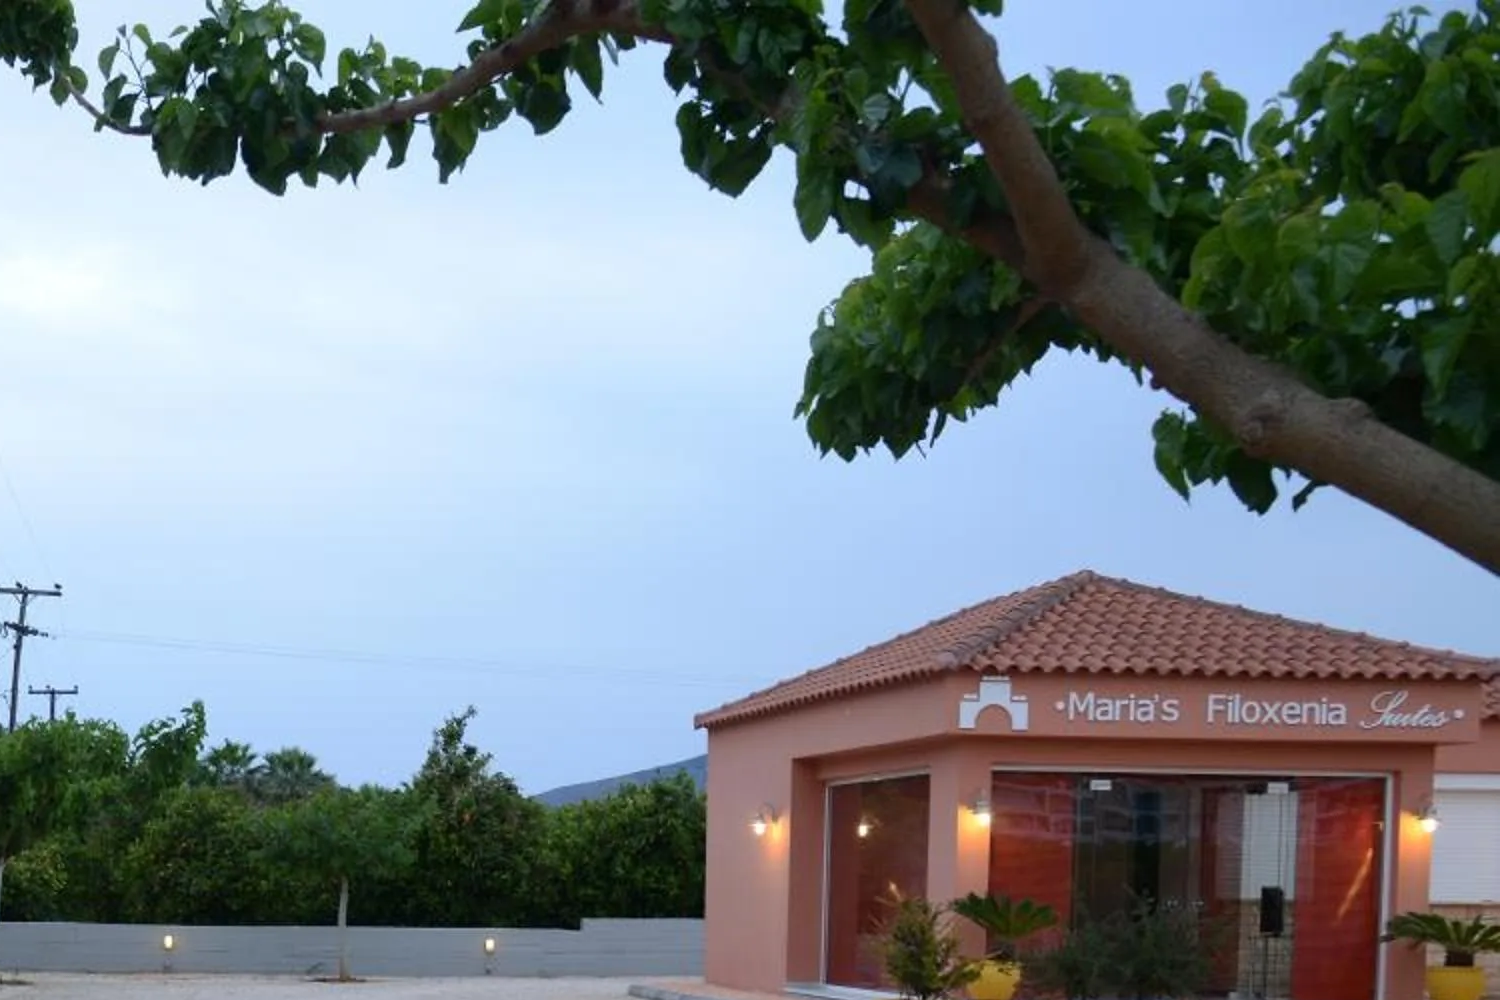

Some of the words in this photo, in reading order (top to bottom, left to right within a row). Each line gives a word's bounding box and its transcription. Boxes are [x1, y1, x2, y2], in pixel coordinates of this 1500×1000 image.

[1068, 691, 1180, 722] Maria's
[1207, 693, 1347, 725] Filoxenia
[1359, 690, 1450, 729] Suites
